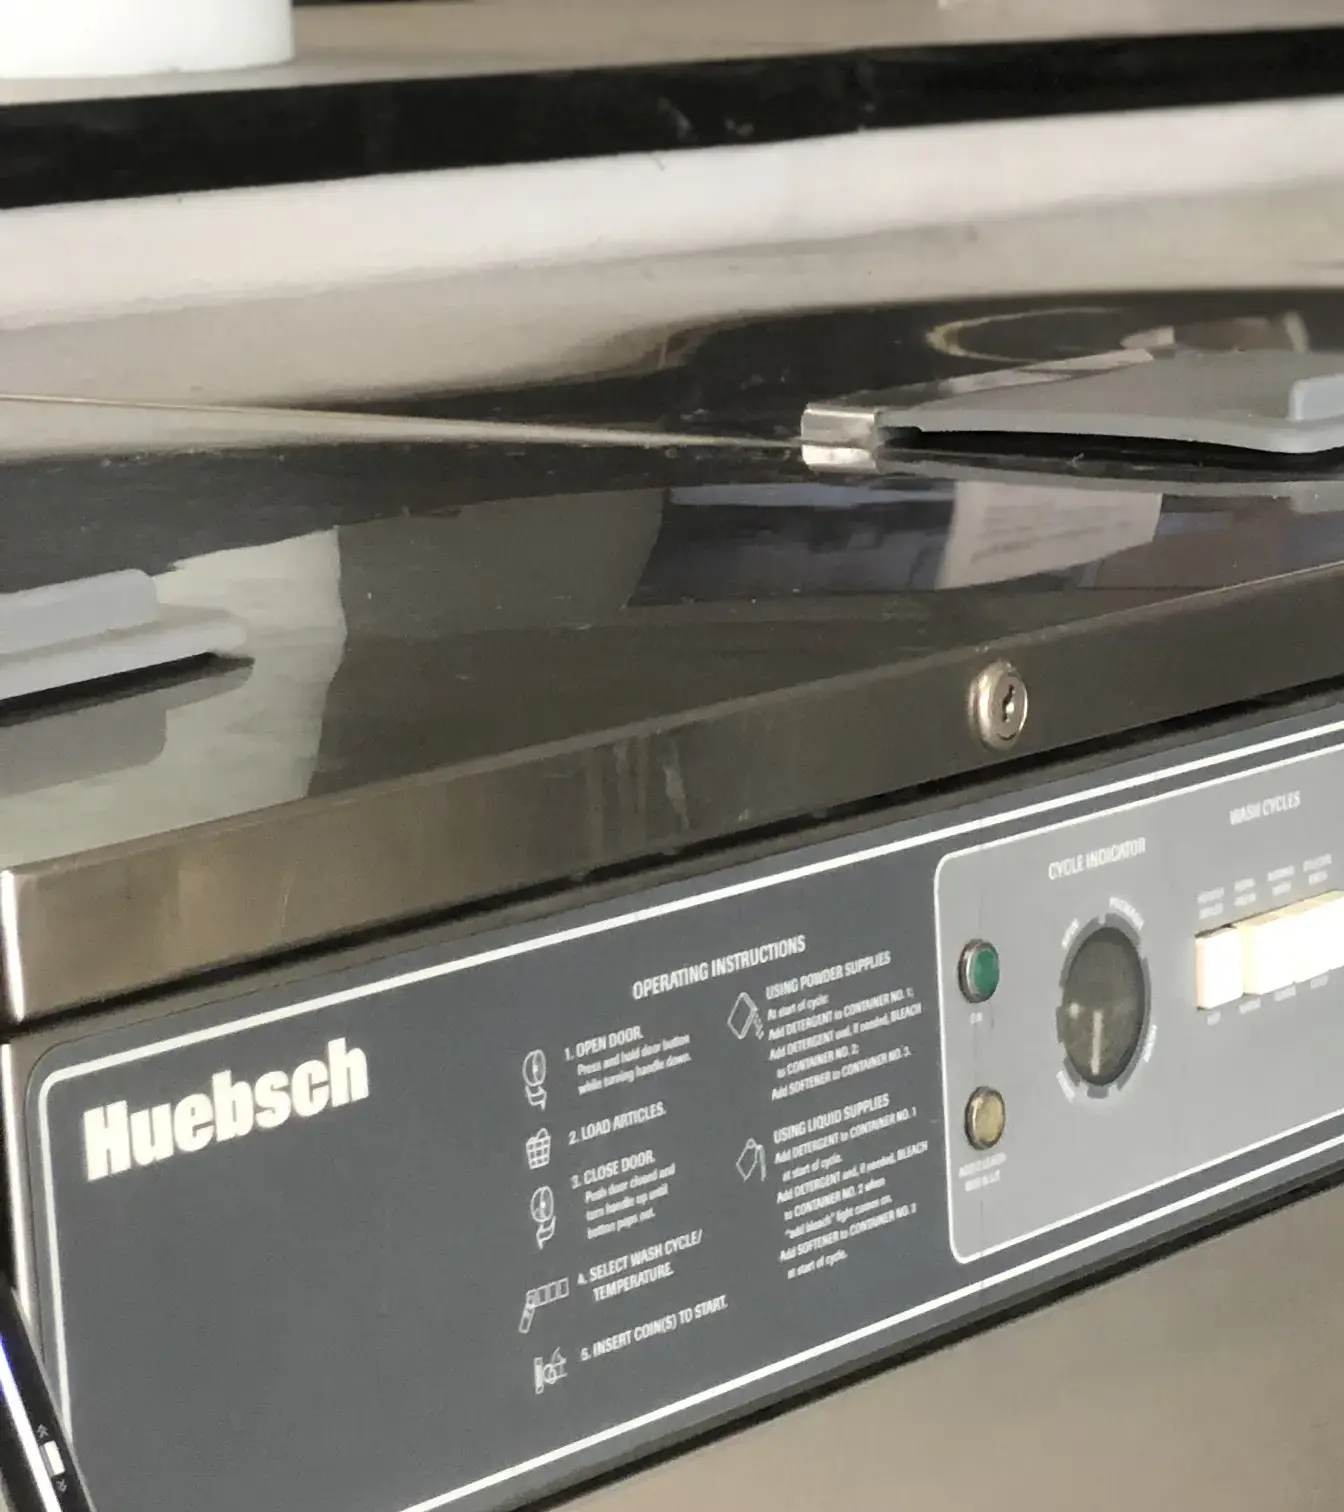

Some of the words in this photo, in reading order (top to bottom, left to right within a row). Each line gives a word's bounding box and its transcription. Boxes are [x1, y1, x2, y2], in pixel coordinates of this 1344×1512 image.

[1230, 802, 1260, 825] WASH
[1263, 791, 1300, 816] CYCLES
[1048, 852, 1084, 880] CYCLE
[1086, 837, 1146, 870] INDICATOR
[632, 962, 709, 1000] OPERATING
[711, 934, 806, 977] INSTRUCTIONS
[766, 978, 798, 1000] USING
[800, 965, 843, 990] POWDER
[845, 950, 891, 976] SUPPLIES
[786, 1010, 832, 1036] DETERGENT
[844, 993, 889, 1017] CONTAINER
[787, 1030, 834, 1055] DETERGENT
[891, 1002, 922, 1023] BLEACH
[565, 1048, 574, 1061] 1.
[576, 1036, 606, 1057] OPEN
[609, 1026, 644, 1048] DOOR.
[787, 1050, 833, 1076] CONTAINER
[789, 1071, 831, 1095] SOFTENER
[842, 1053, 887, 1077] CONTAINER
[83, 1037, 369, 1181] Huebsch
[568, 1131, 579, 1145] 2.
[581, 1118, 610, 1141] LOAD
[613, 1101, 667, 1131] ARTICLES.
[774, 1121, 806, 1144] USING
[807, 1109, 842, 1132] LIQUID
[844, 1093, 890, 1120] SUPPLIES
[793, 1132, 839, 1158] DETERGENT
[850, 1112, 895, 1138] CONTAINER
[570, 1175, 581, 1189] 3.
[584, 1160, 619, 1185] CLOSE
[794, 1171, 840, 1197] DETERGENT
[897, 1140, 928, 1161] BLEACH
[794, 1191, 841, 1216] CONTAINER
[590, 1255, 628, 1281] SELECT
[631, 1243, 662, 1267] WASH
[665, 1228, 702, 1255] CYCLE/
[798, 1230, 839, 1256] SOFTENER
[850, 1210, 895, 1236] CONTAINER
[593, 1262, 674, 1301] TEMPERATURE.
[580, 1348, 591, 1361] 5.
[593, 1330, 631, 1357] INSERT
[634, 1314, 677, 1341] COIN(S)
[679, 1308, 693, 1323] TO
[695, 1295, 728, 1319] START.
